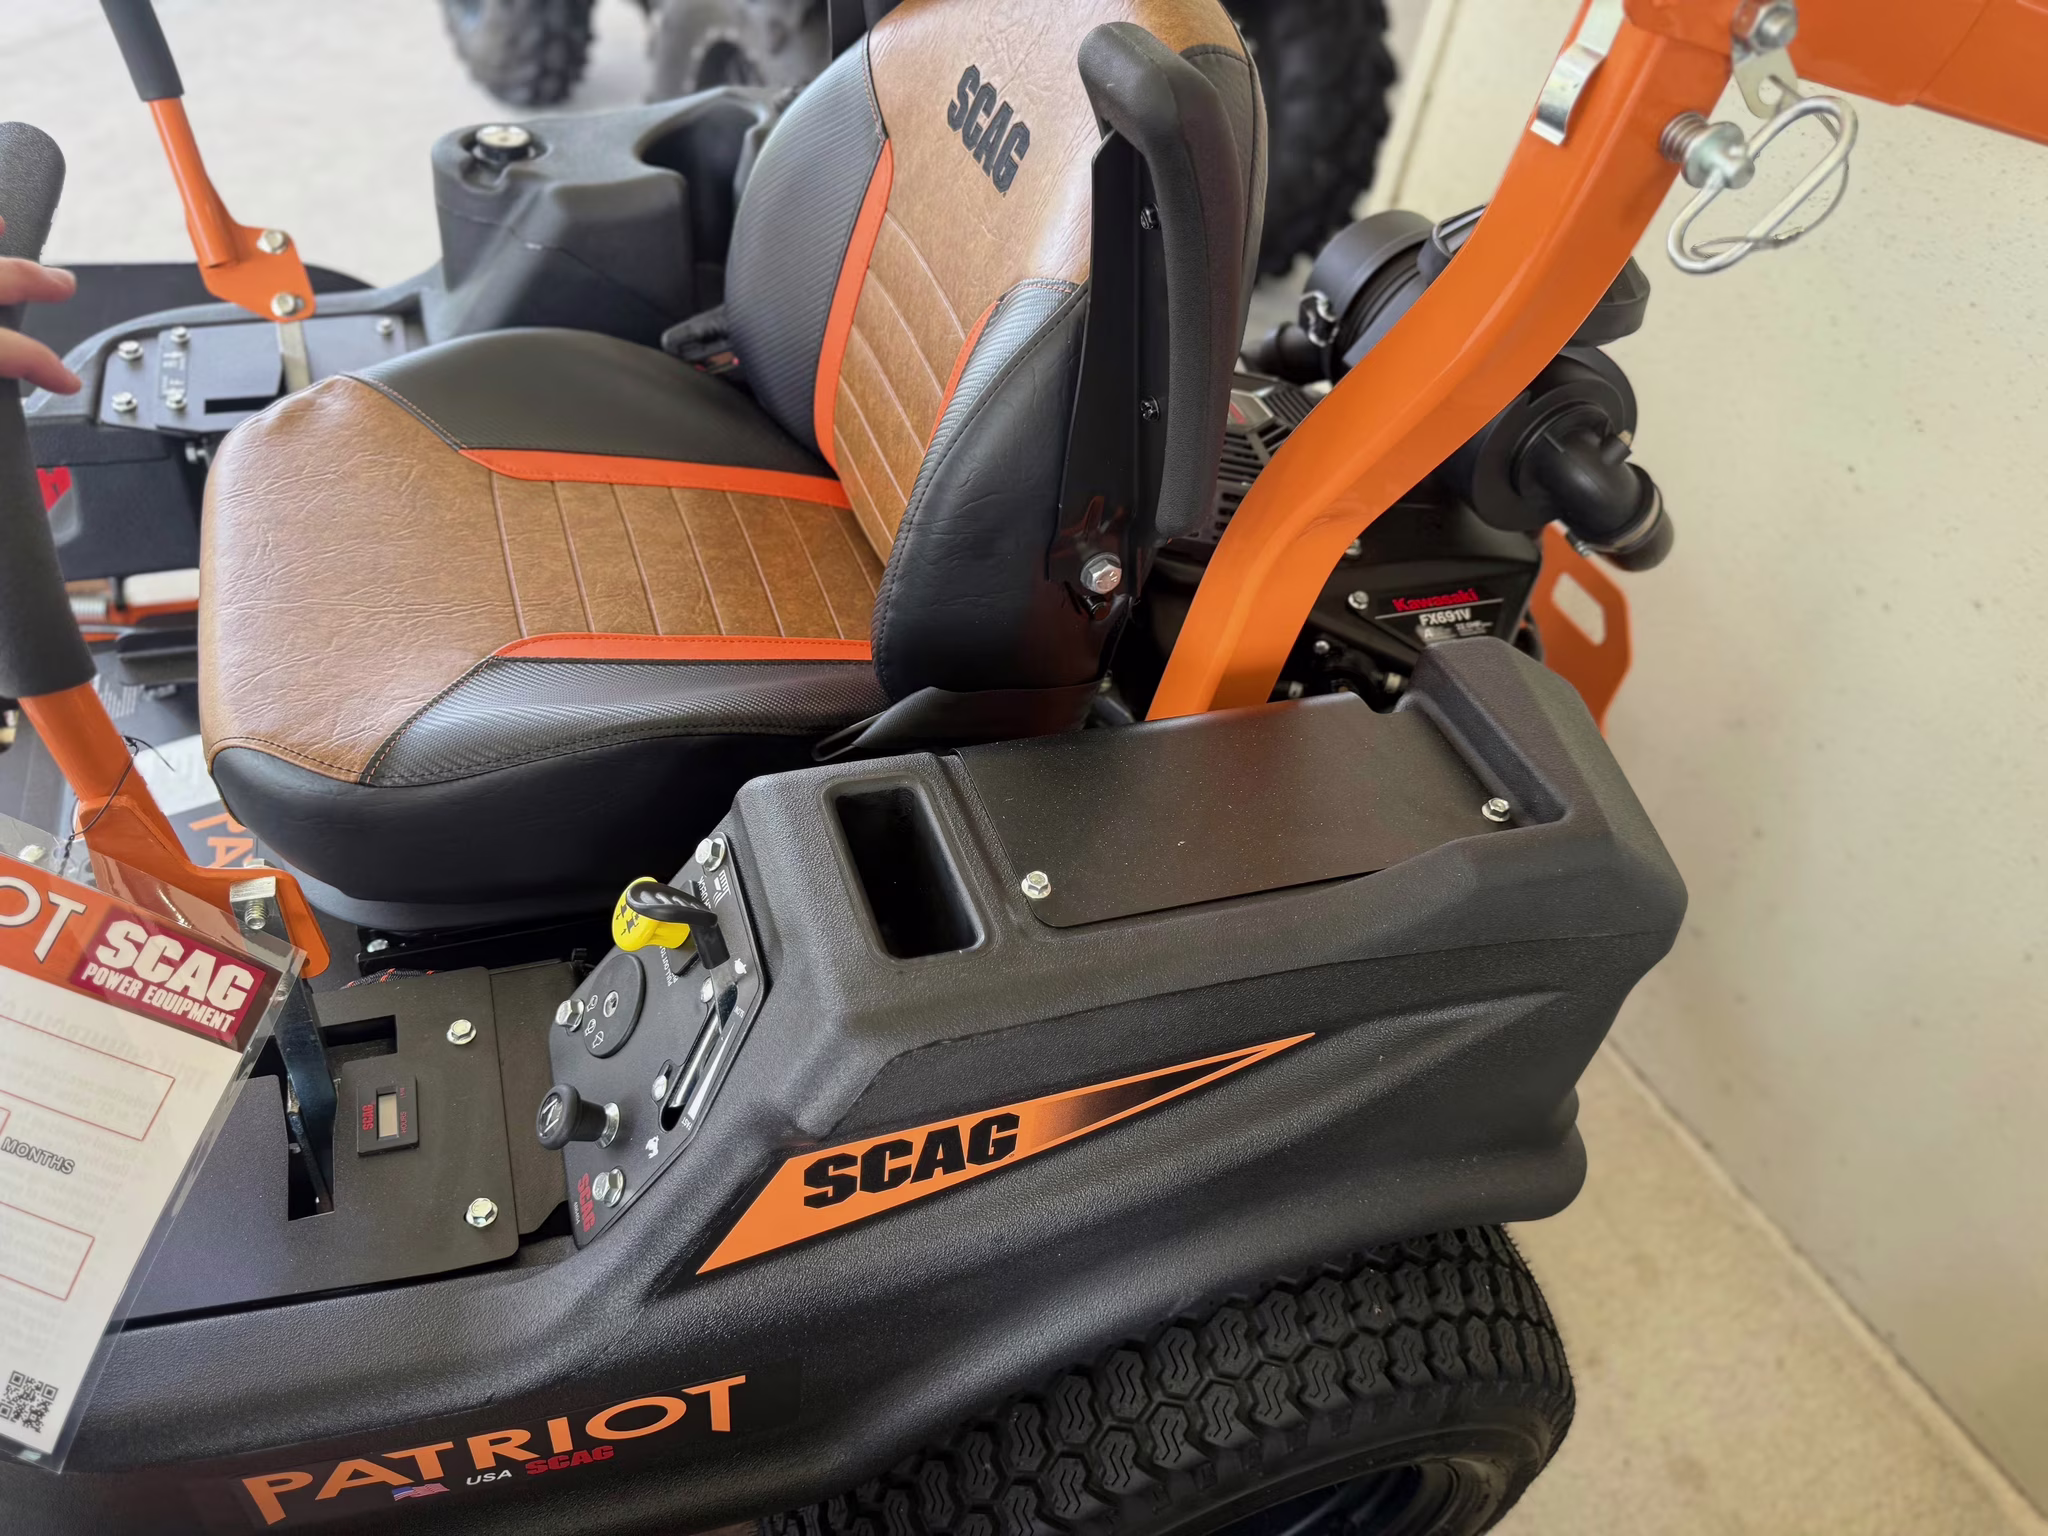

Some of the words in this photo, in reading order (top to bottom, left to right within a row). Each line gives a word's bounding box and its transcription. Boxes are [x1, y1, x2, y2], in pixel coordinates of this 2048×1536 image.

[947, 63, 1030, 194] SCAG
[1392, 588, 1479, 612] Kawasaki
[1419, 608, 1471, 627] FX691V
[95, 919, 255, 1012] SCAG
[80, 961, 144, 1000] POWER
[141, 984, 236, 1034] EQUIPMENT
[362, 1104, 375, 1131] SCAG
[681, 1116, 693, 1131] FAST
[0, 1136, 76, 1175] MONTHS
[803, 1112, 1020, 1209] SCAG
[577, 1172, 596, 1233] SCAG
[242, 1375, 746, 1525] PATRIOT
[466, 1469, 513, 1486] USA
[525, 1445, 615, 1475] SCAG
